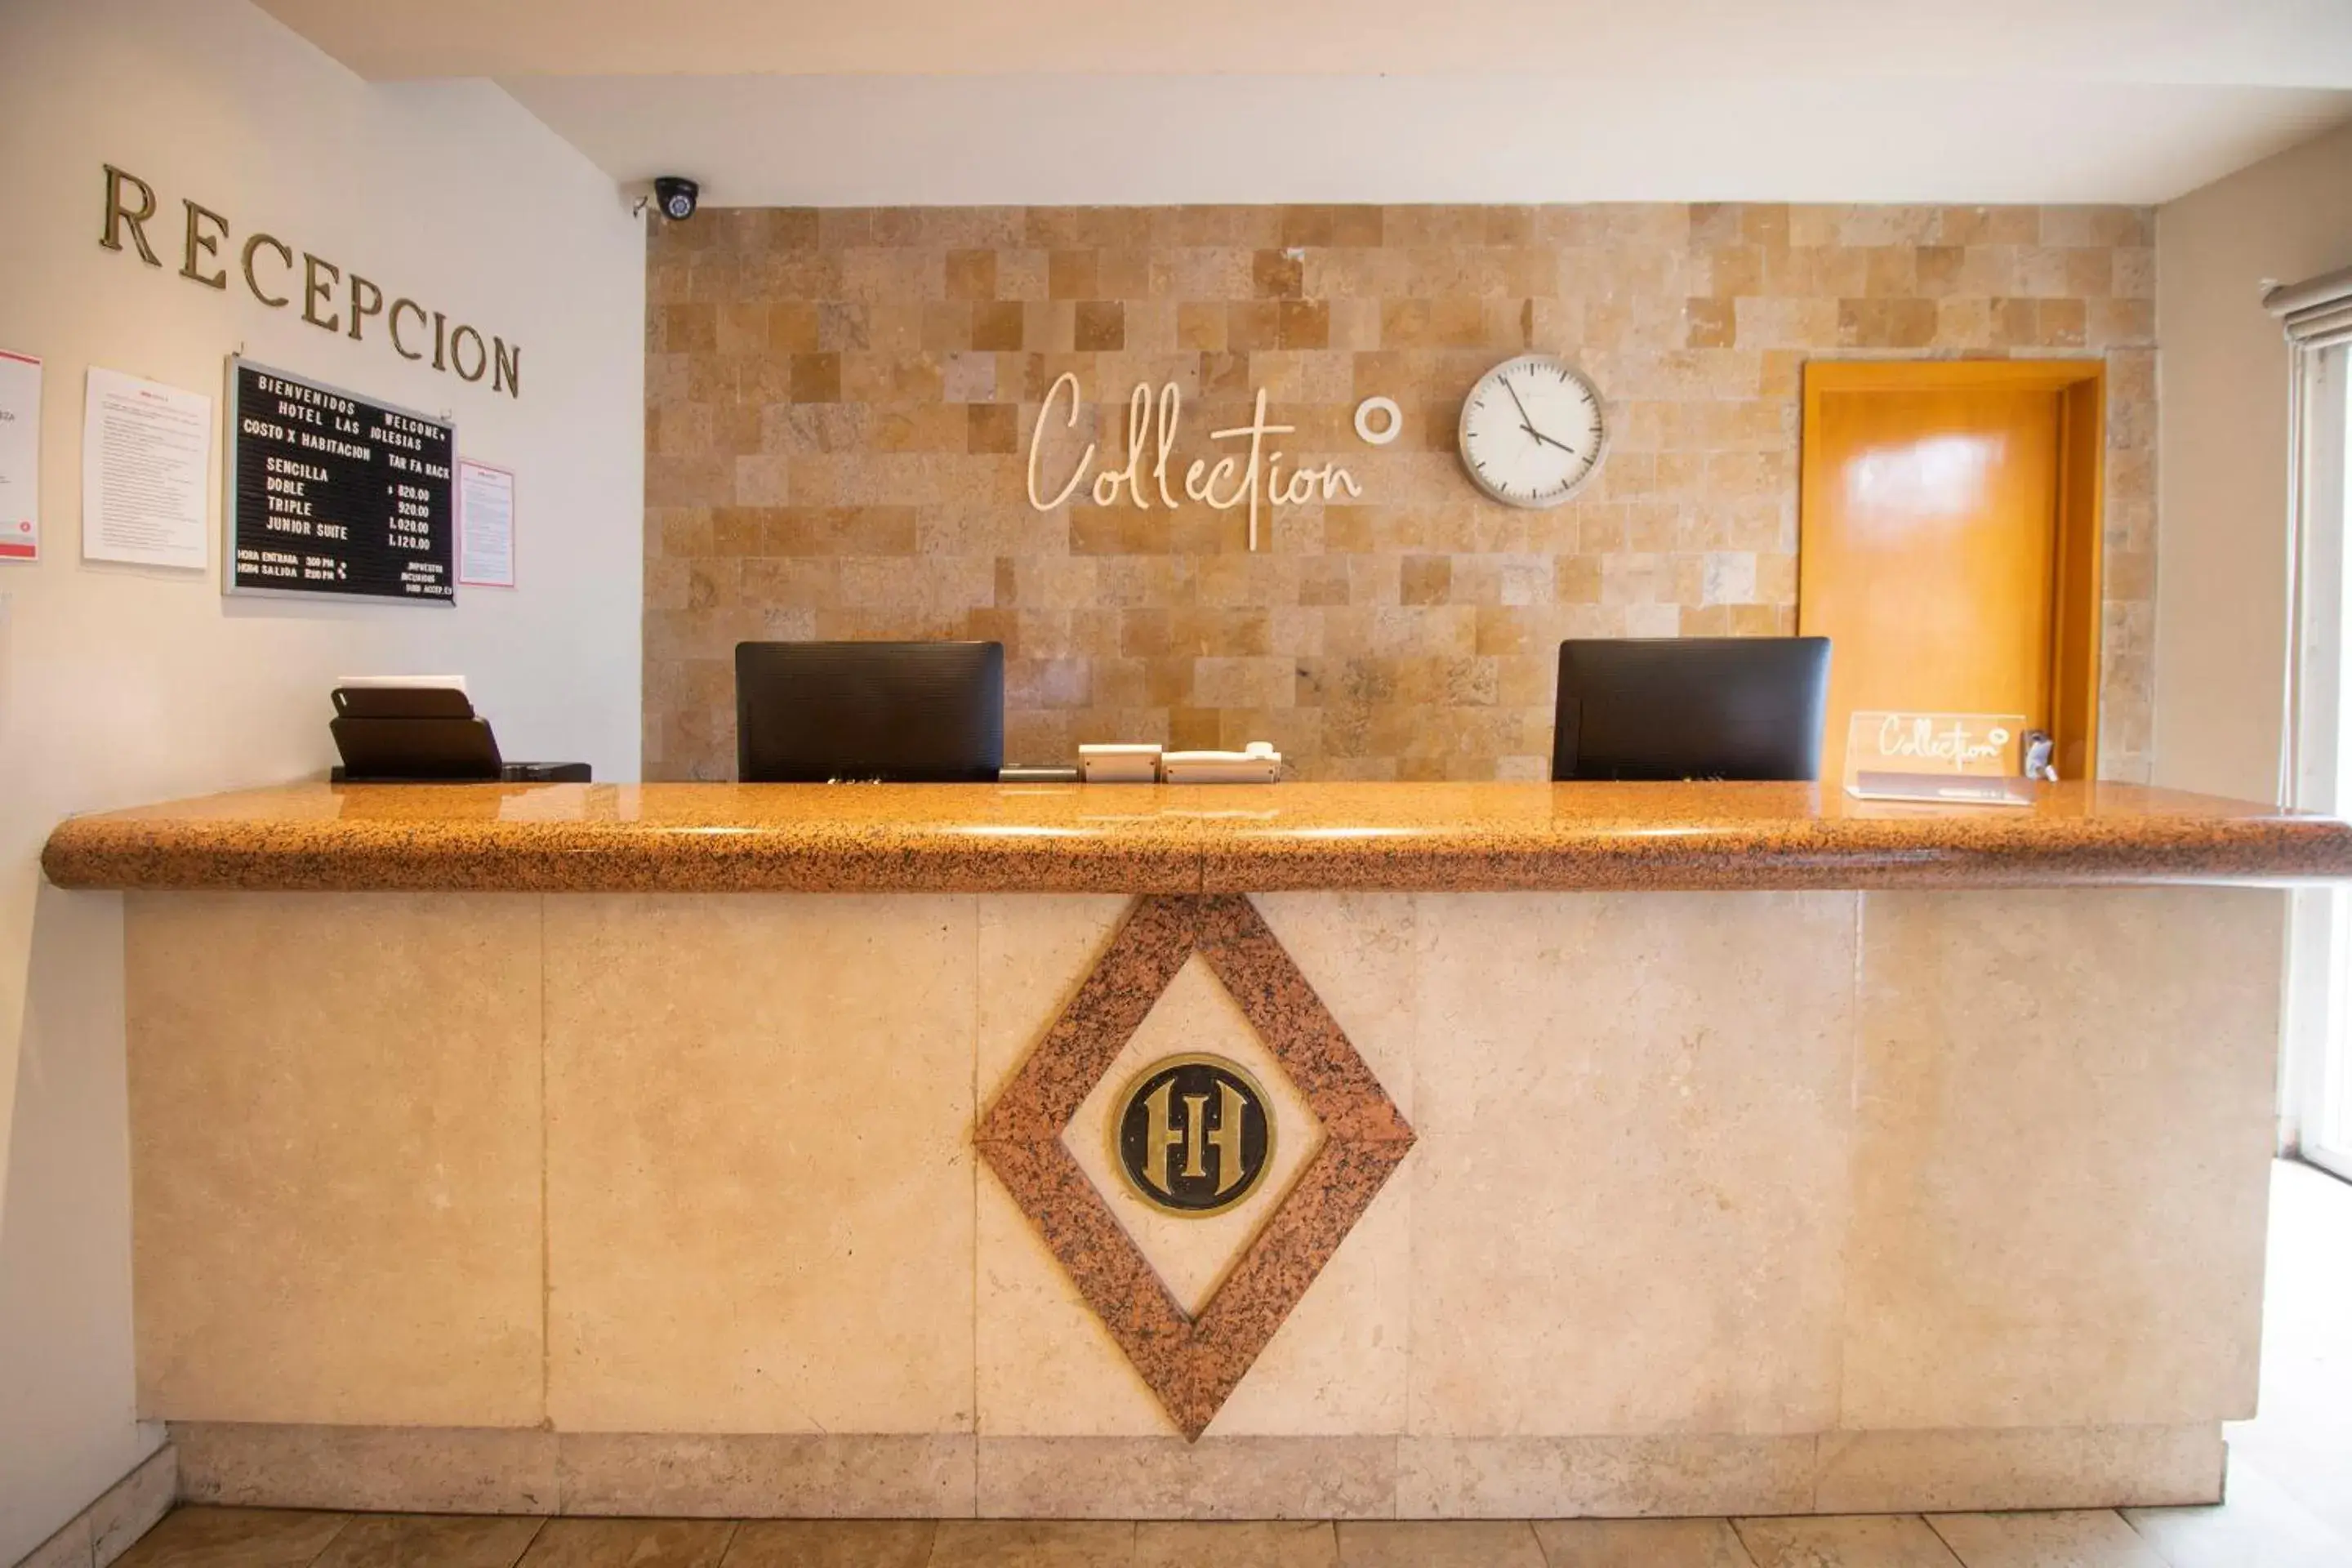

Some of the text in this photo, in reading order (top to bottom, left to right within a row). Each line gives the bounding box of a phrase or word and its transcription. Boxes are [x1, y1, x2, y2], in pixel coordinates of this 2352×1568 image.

[99, 163, 520, 399] RECEPCION
[258, 376, 355, 415] BIENVENIDOS
[243, 419, 283, 439] COSTO
[287, 429, 296, 443] X
[301, 432, 371, 461] HABITACION
[278, 401, 421, 451] HOTEL LAS IGLESIAS
[266, 457, 328, 482] SENCILLA
[1027, 372, 1362, 551] Collection
[267, 476, 429, 518] DOBLE 920.00
[267, 496, 313, 516] TRIPLE
[266, 516, 311, 535] JUNIOR
[317, 523, 348, 540] SUITE
[238, 550, 259, 560] HORA
[323, 558, 334, 568] PM
[261, 565, 297, 577] SALIDA
[1878, 715, 1998, 772] Collection
